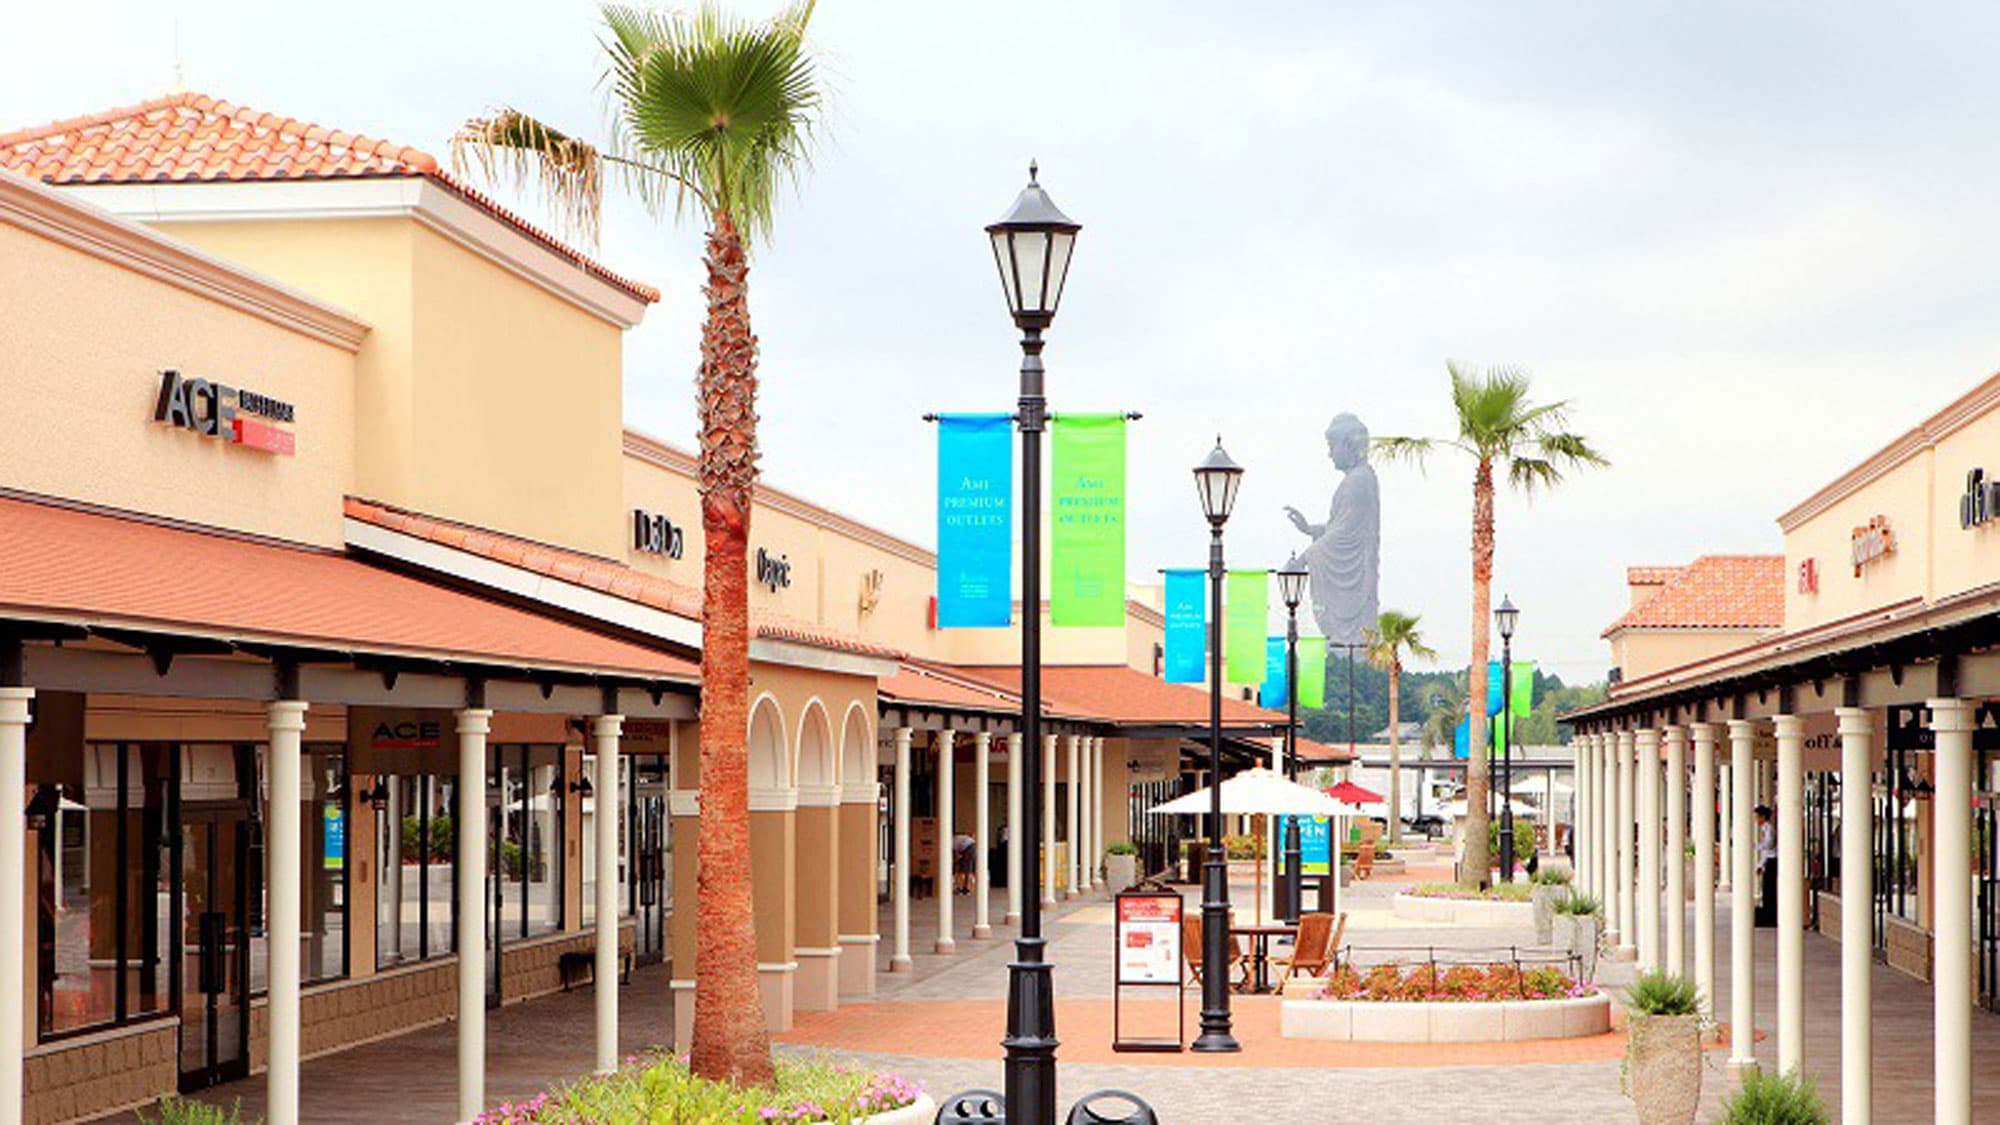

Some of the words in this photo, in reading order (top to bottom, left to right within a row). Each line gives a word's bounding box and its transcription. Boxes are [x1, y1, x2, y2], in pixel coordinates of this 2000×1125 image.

[154, 369, 236, 438] ACE
[945, 497, 1004, 509] PREMIUM
[946, 514, 1004, 526] OUTLETS
[1899, 709, 1998, 728] PLA
[374, 722, 441, 738] ACE
